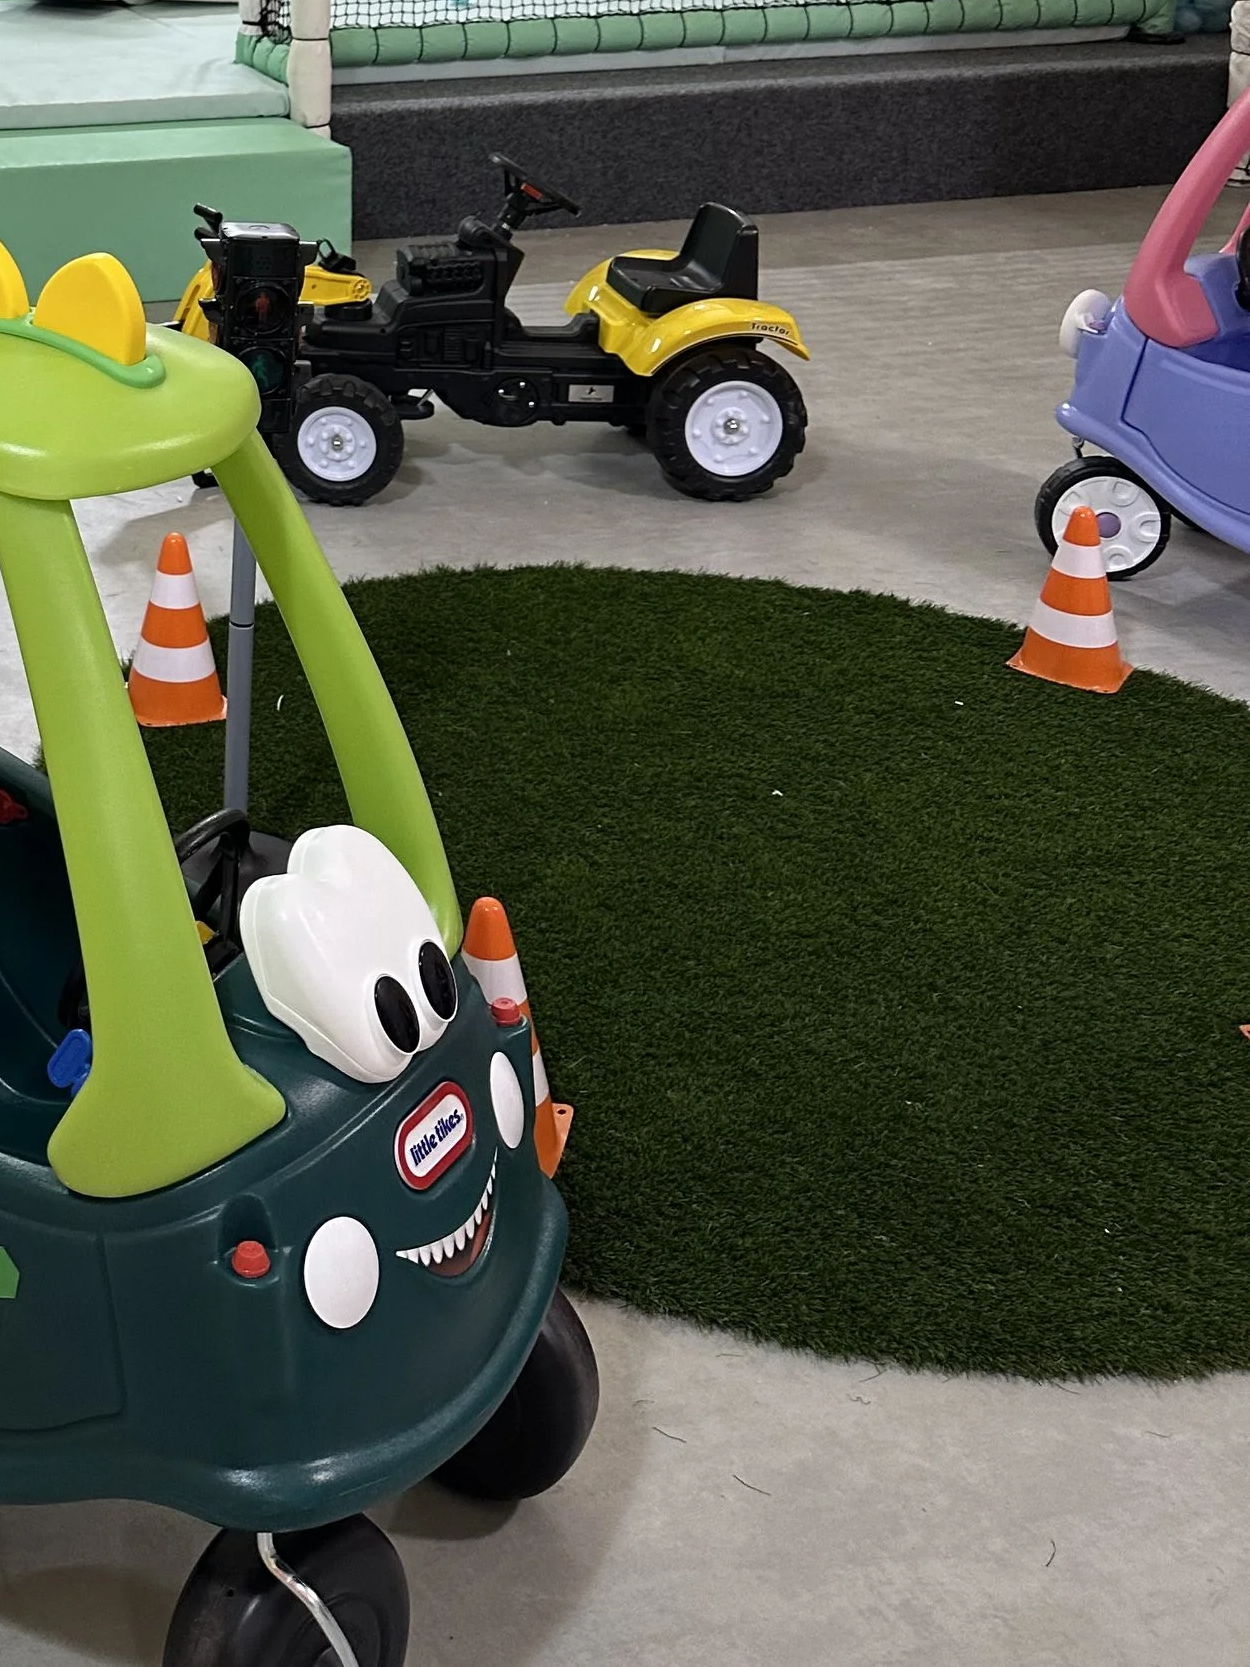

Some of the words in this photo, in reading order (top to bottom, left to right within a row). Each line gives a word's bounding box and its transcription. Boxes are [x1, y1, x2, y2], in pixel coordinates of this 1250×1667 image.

[751, 322, 789, 335] Tractor
[410, 1134, 438, 1167] little
[434, 1109, 461, 1142] tikes
